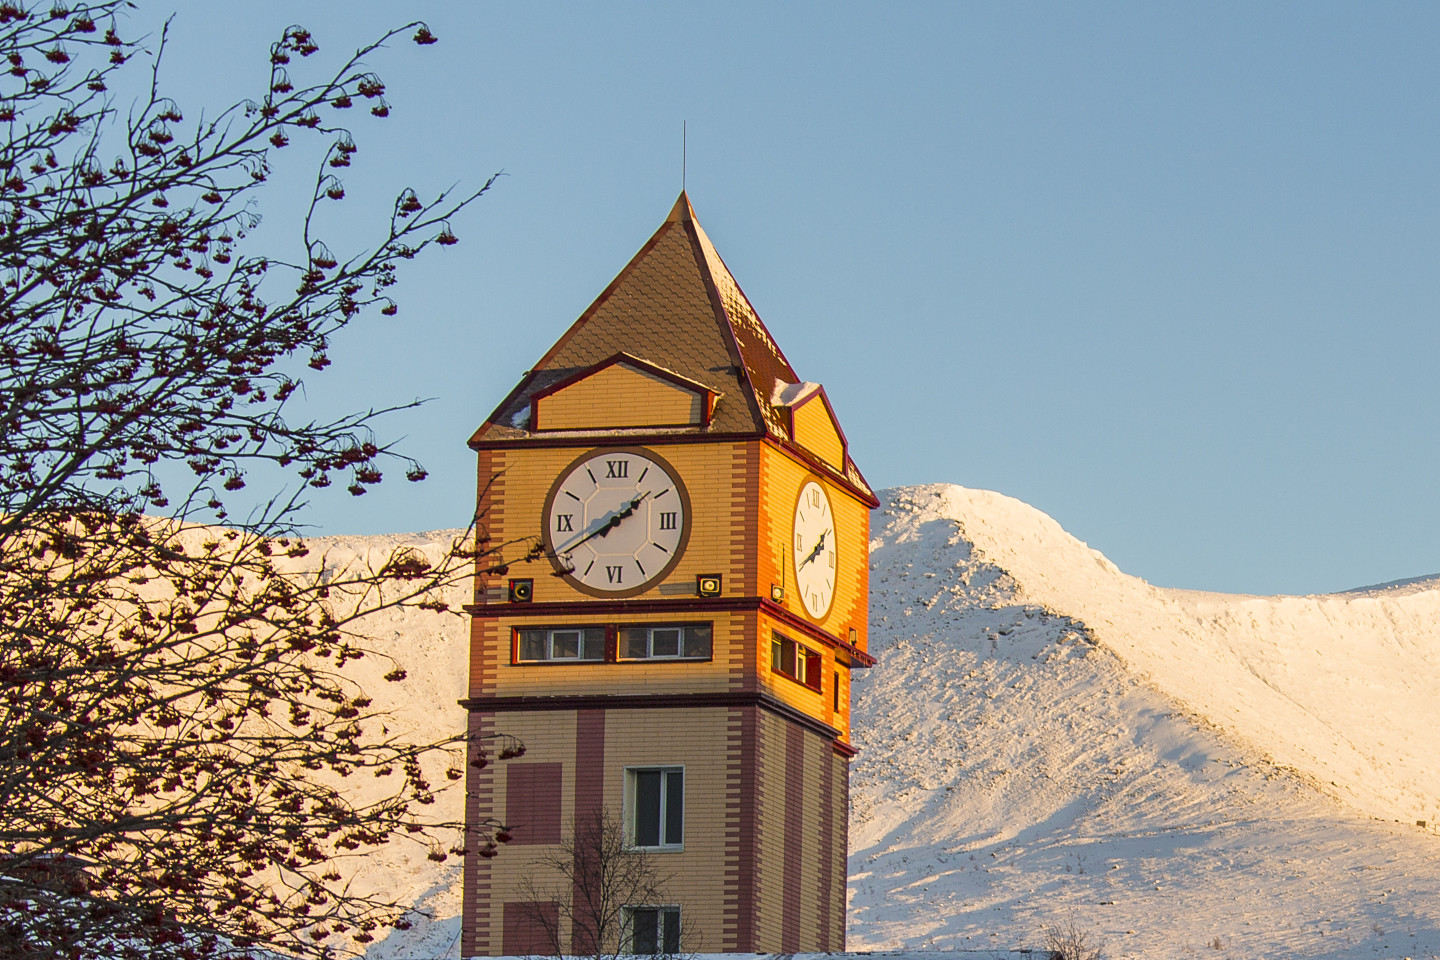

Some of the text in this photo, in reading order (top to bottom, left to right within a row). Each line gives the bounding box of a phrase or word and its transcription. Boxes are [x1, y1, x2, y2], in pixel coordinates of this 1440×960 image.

[605, 460, 629, 478] XII
[556, 514, 574, 532] IX
[659, 512, 677, 530] III
[605, 566, 623, 584] VI
